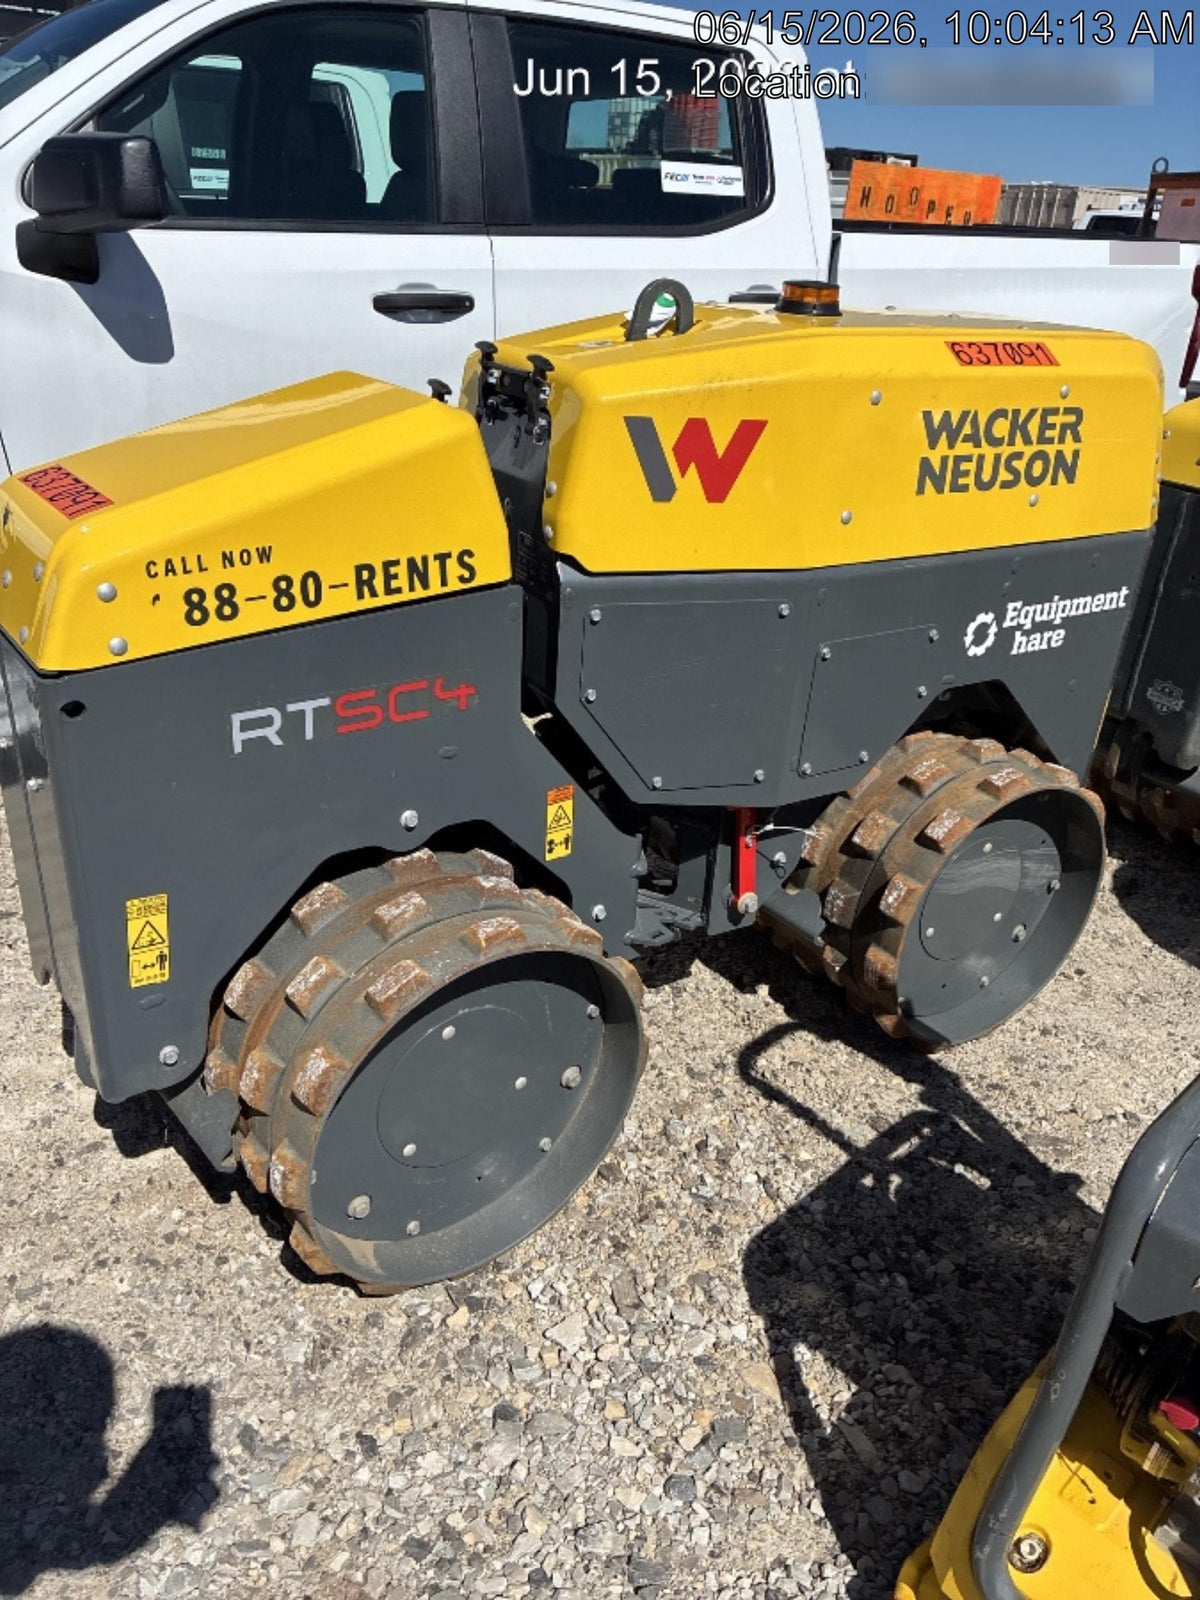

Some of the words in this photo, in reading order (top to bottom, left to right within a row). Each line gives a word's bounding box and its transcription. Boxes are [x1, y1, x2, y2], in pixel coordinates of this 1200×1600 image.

[950, 342, 1054, 366] 637091
[921, 406, 1084, 451] WACKER
[22, 466, 107, 517] 637091
[915, 448, 1081, 496] NEUSON
[145, 554, 209, 579] CALL
[221, 545, 273, 570] NOW
[1002, 585, 1130, 631] Equipment
[1010, 628, 1066, 656] hare
[230, 676, 477, 754] RTSC4
